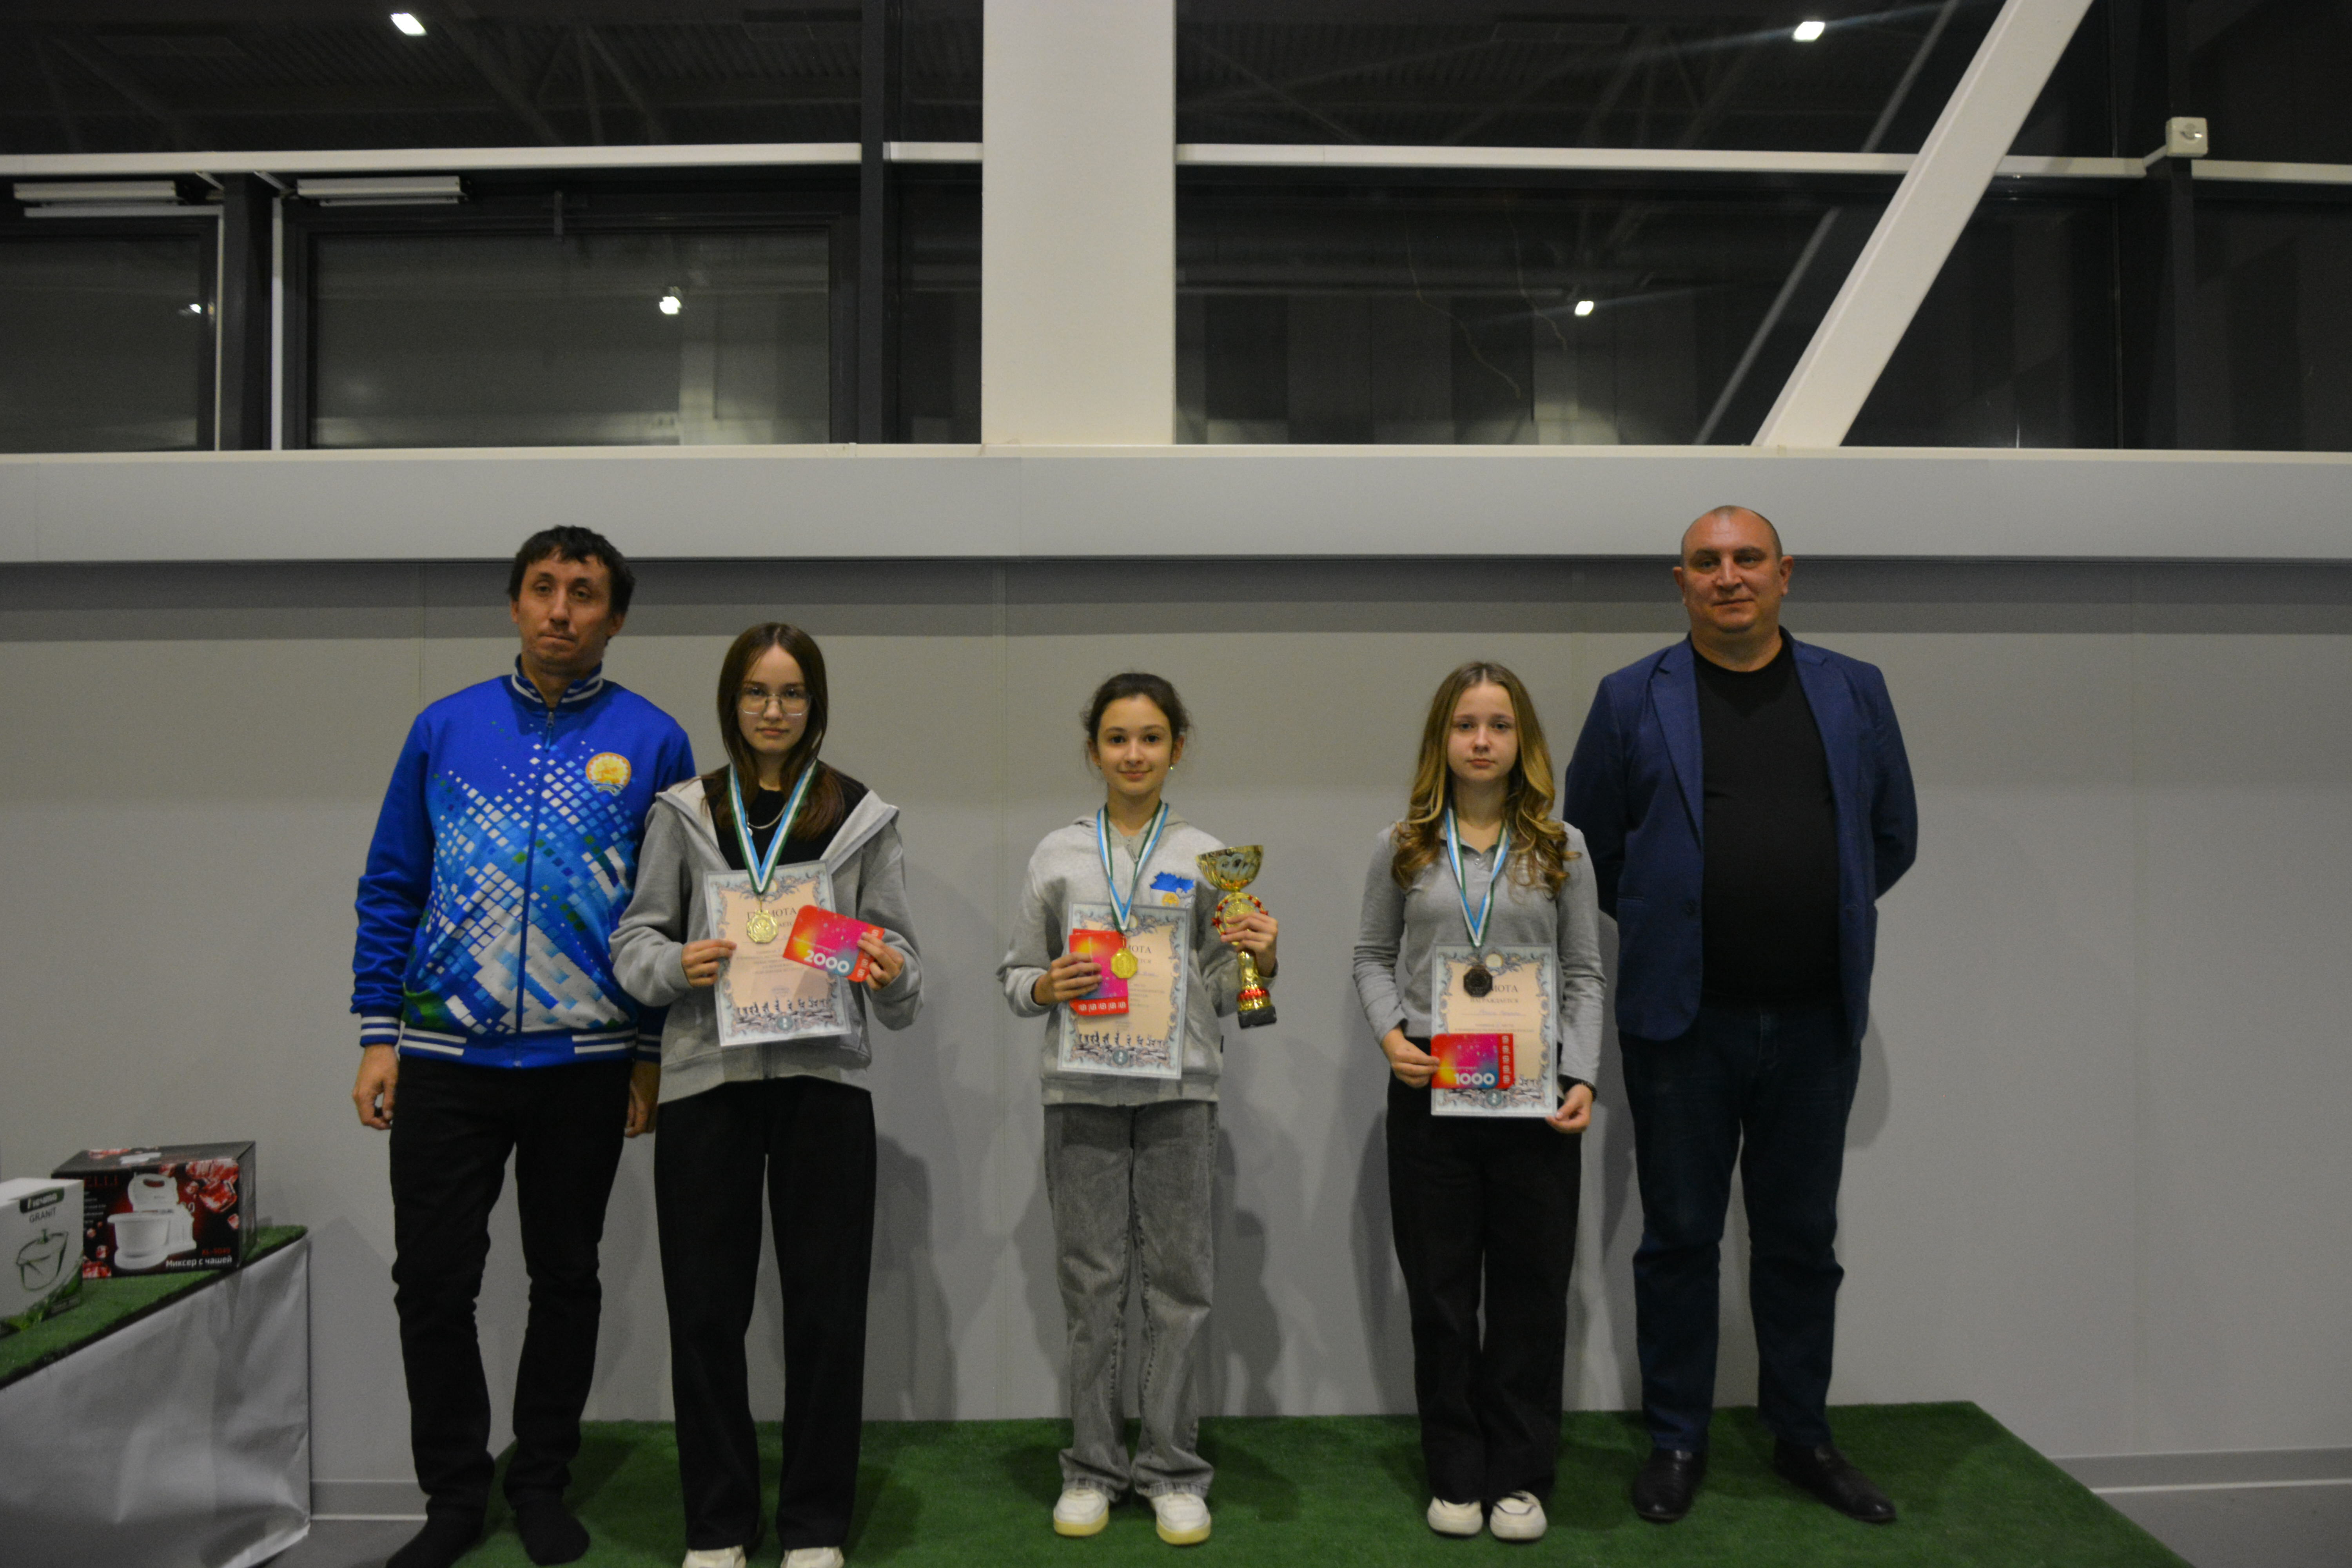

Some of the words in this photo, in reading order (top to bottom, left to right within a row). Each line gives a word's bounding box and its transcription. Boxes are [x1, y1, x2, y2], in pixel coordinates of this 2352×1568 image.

[804, 950, 850, 973] 2000
[1454, 1073, 1495, 1085] 1000
[166, 1259, 196, 1268] Миксер
[205, 1255, 232, 1265] чашей
